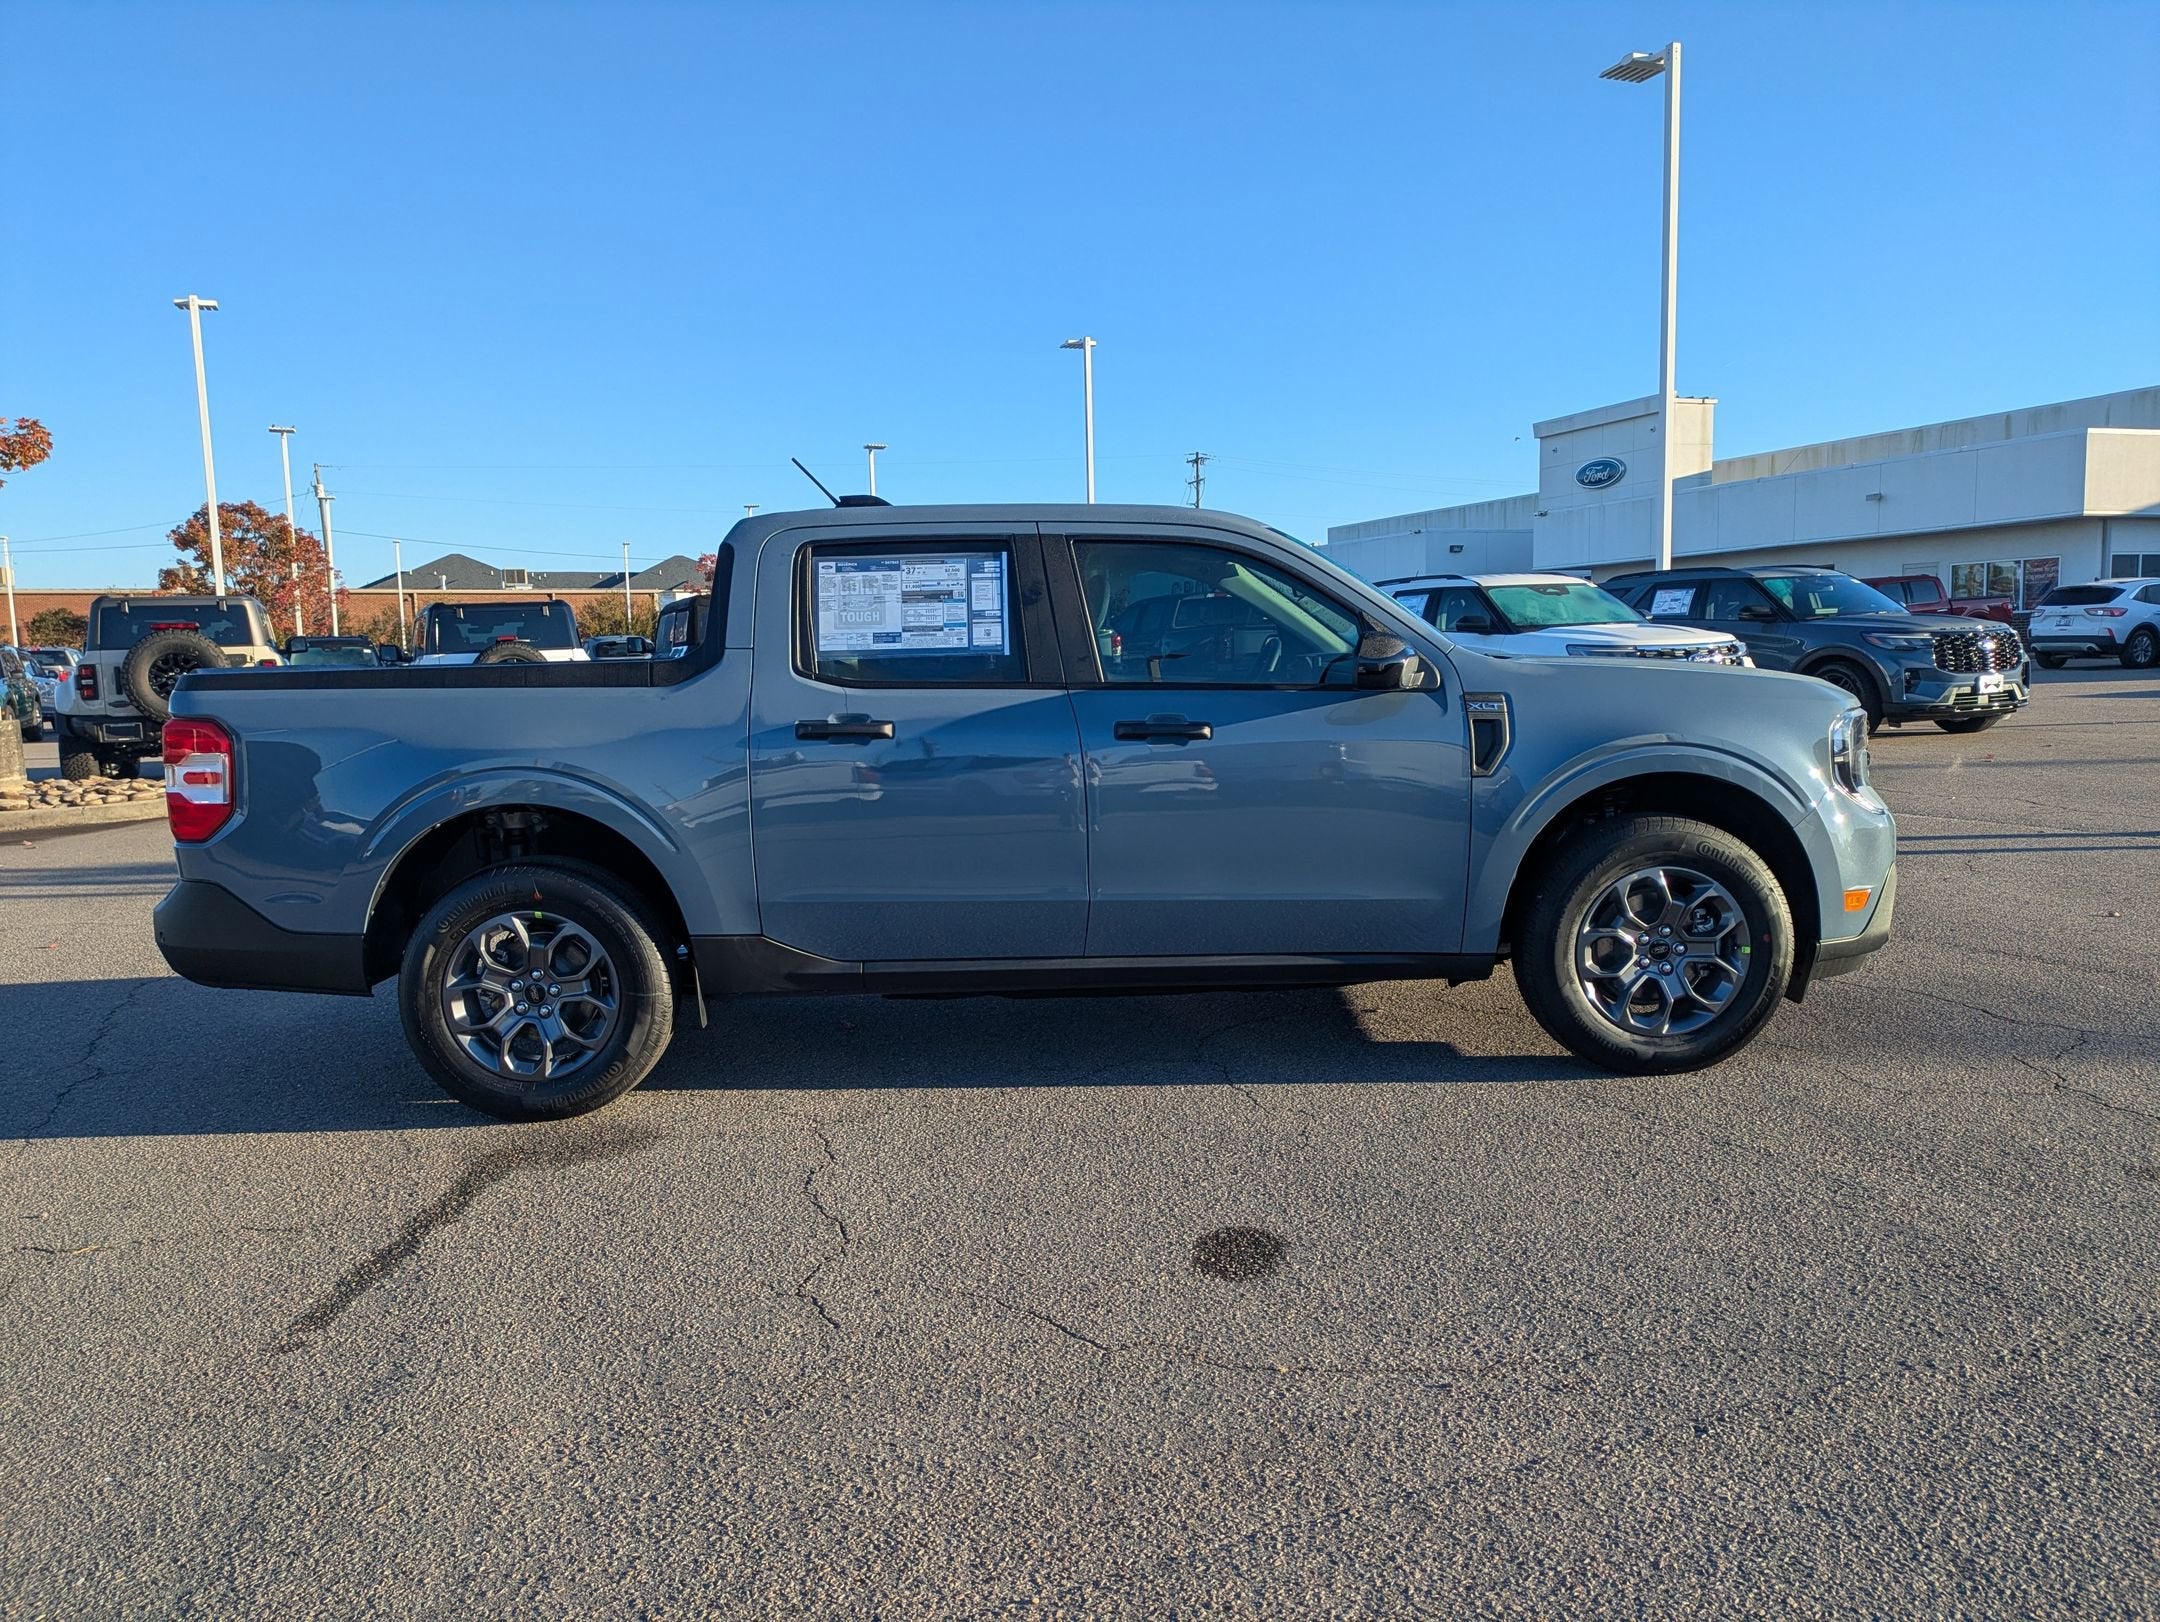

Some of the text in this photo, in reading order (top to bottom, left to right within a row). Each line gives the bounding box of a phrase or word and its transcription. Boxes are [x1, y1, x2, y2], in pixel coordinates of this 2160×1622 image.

[1583, 464, 1610, 483] Ford
[839, 611, 880, 623] TOUGH
[1467, 701, 1503, 711] XLT
[1695, 840, 1766, 893] Continental
